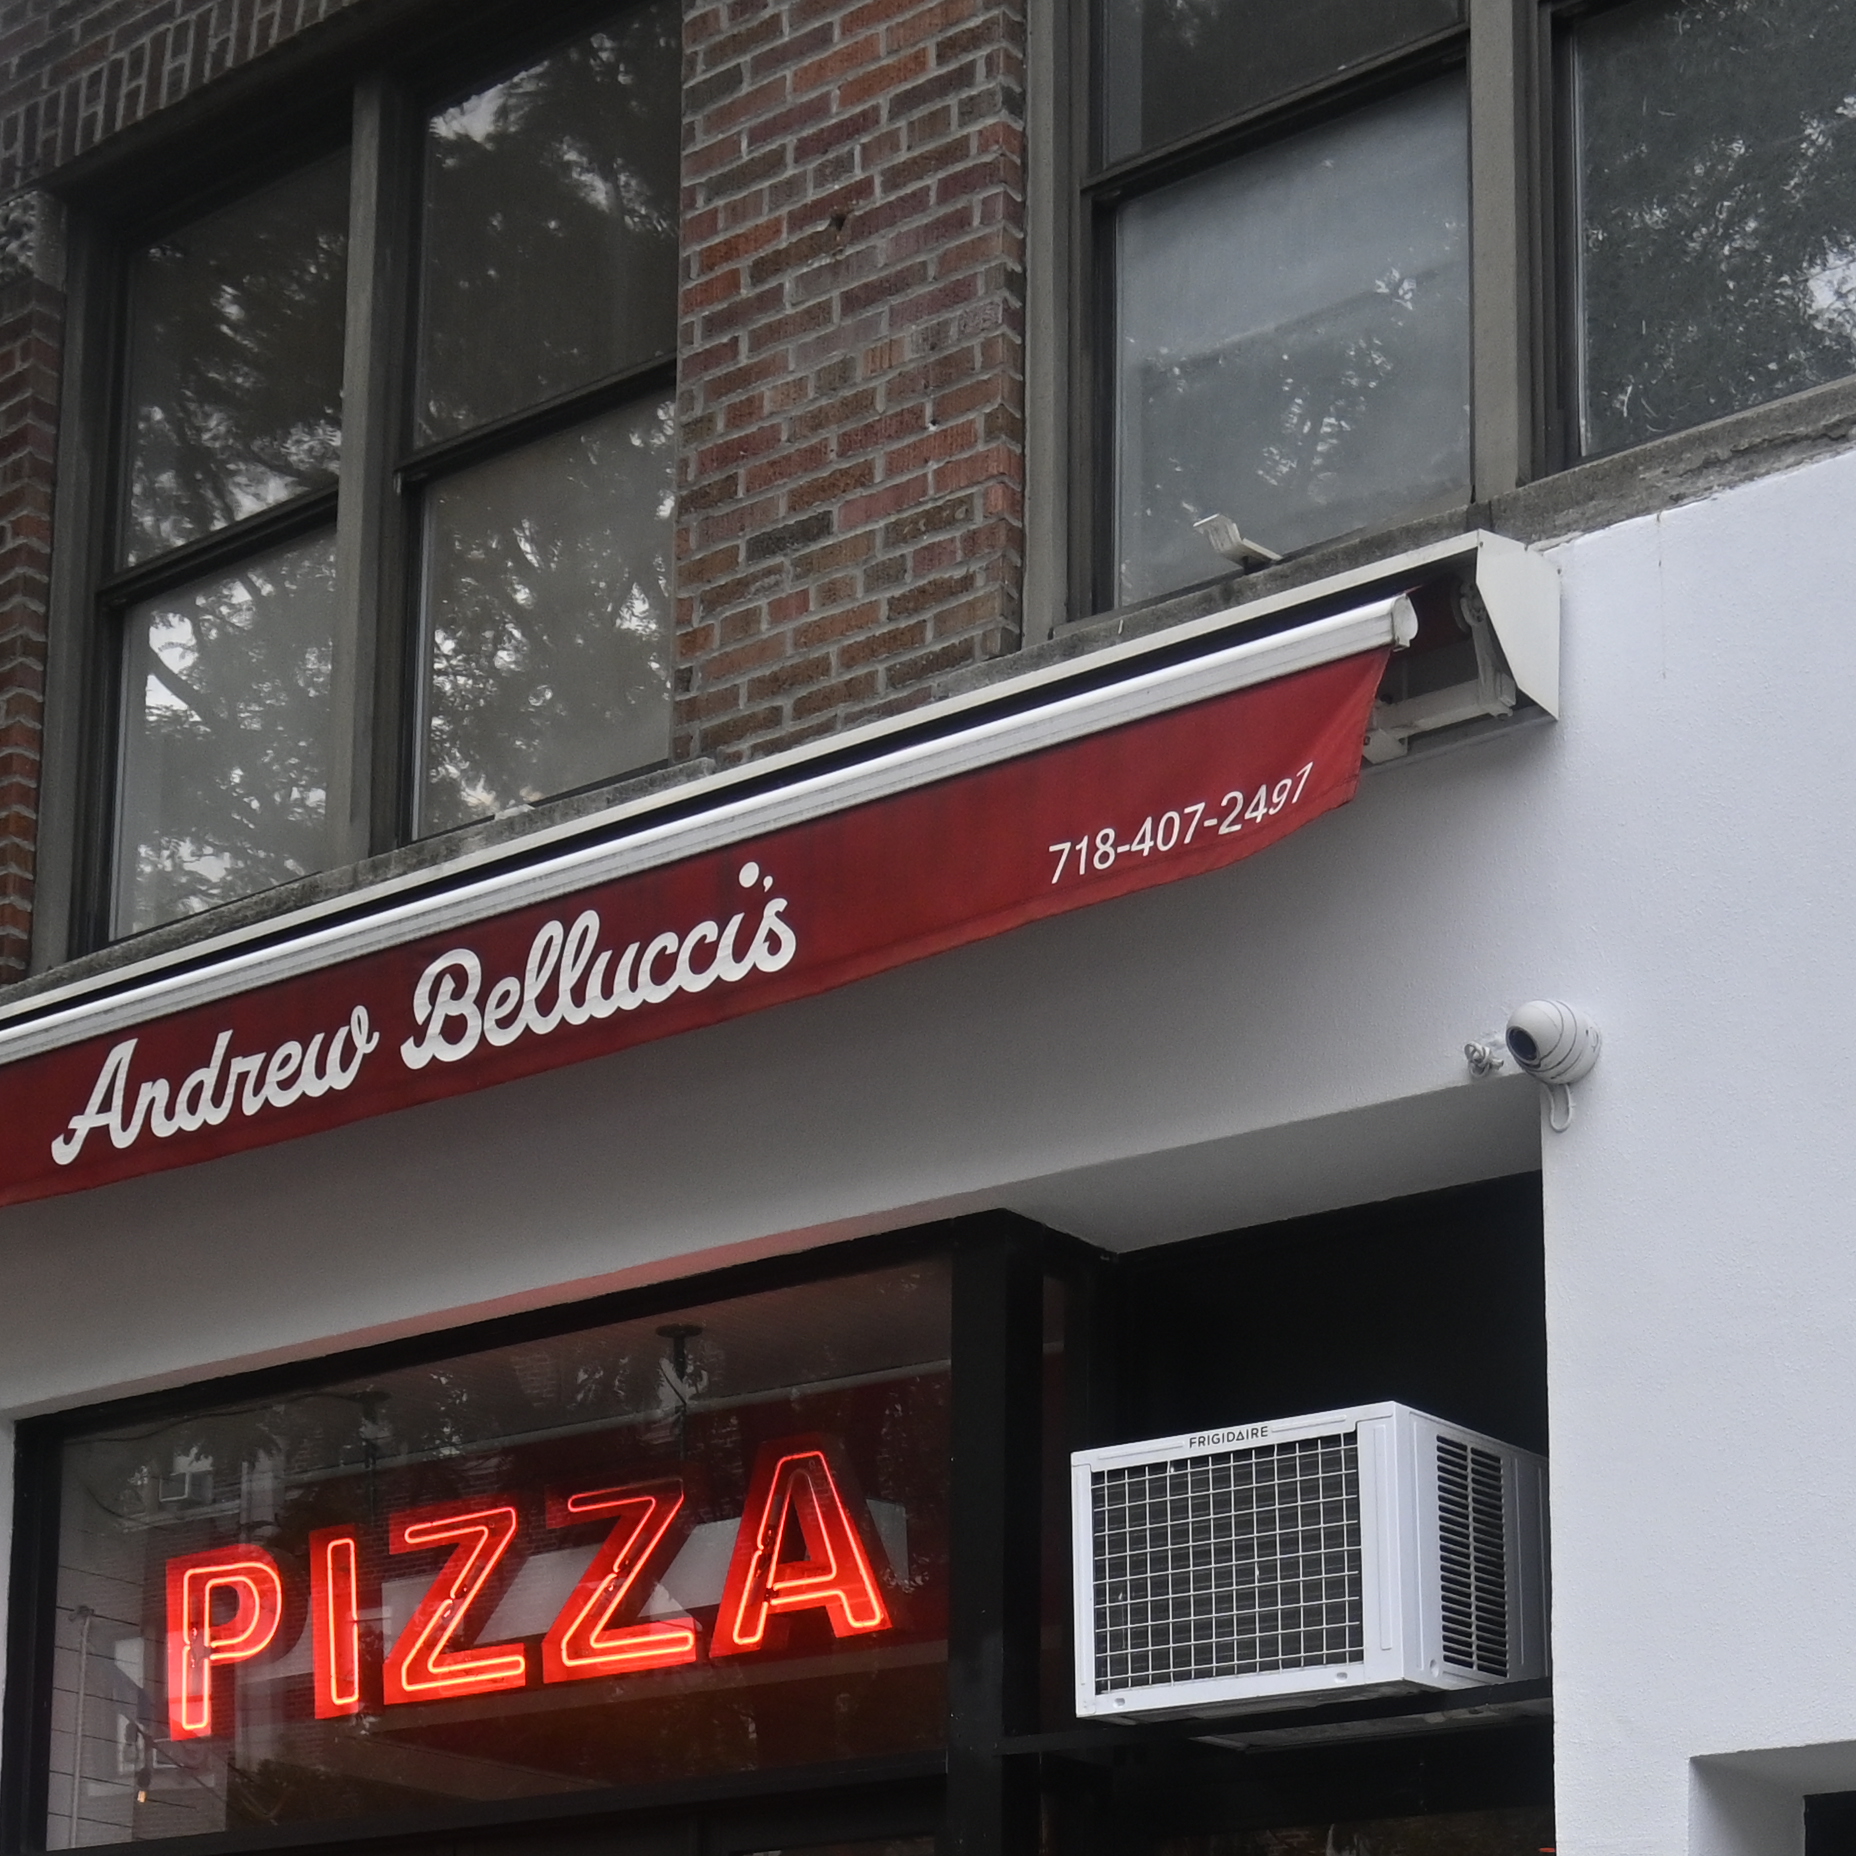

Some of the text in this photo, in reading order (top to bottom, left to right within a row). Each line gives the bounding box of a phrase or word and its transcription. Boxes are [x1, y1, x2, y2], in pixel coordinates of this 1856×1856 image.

[1047, 760, 1314, 886] 718-407-2497
[49, 859, 798, 1168] Andrew Bellucci's
[1188, 1426, 1269, 1449] FRIGIDAIRE
[165, 1433, 891, 1742] PIZZA
